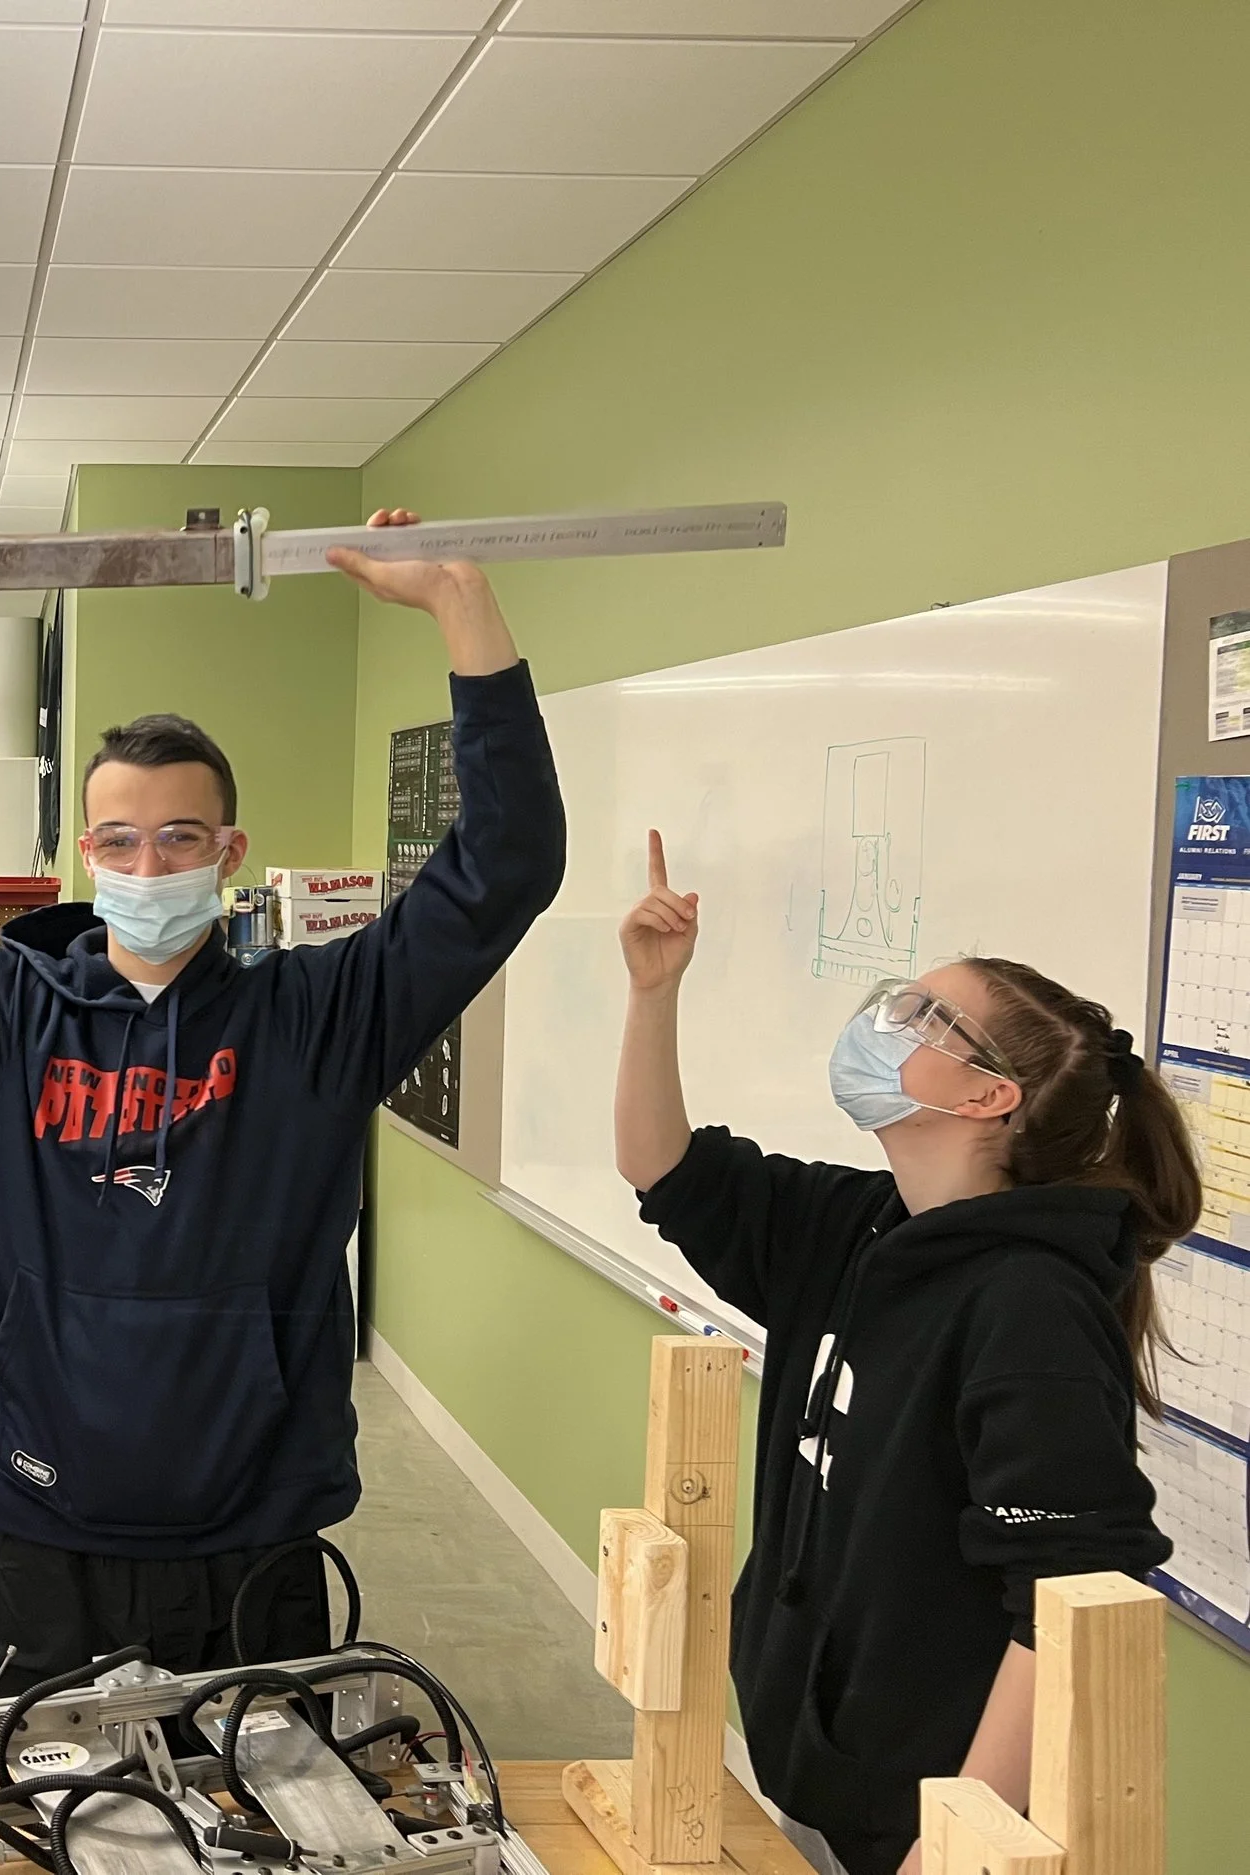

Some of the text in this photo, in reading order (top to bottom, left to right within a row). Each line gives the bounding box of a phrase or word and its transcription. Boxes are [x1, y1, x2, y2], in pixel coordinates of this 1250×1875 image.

[1188, 824, 1230, 841] FIRST
[1204, 847, 1236, 855] RELATIONS
[48, 1063, 102, 1090] NEW
[22, 1752, 71, 1764] SAFETY
